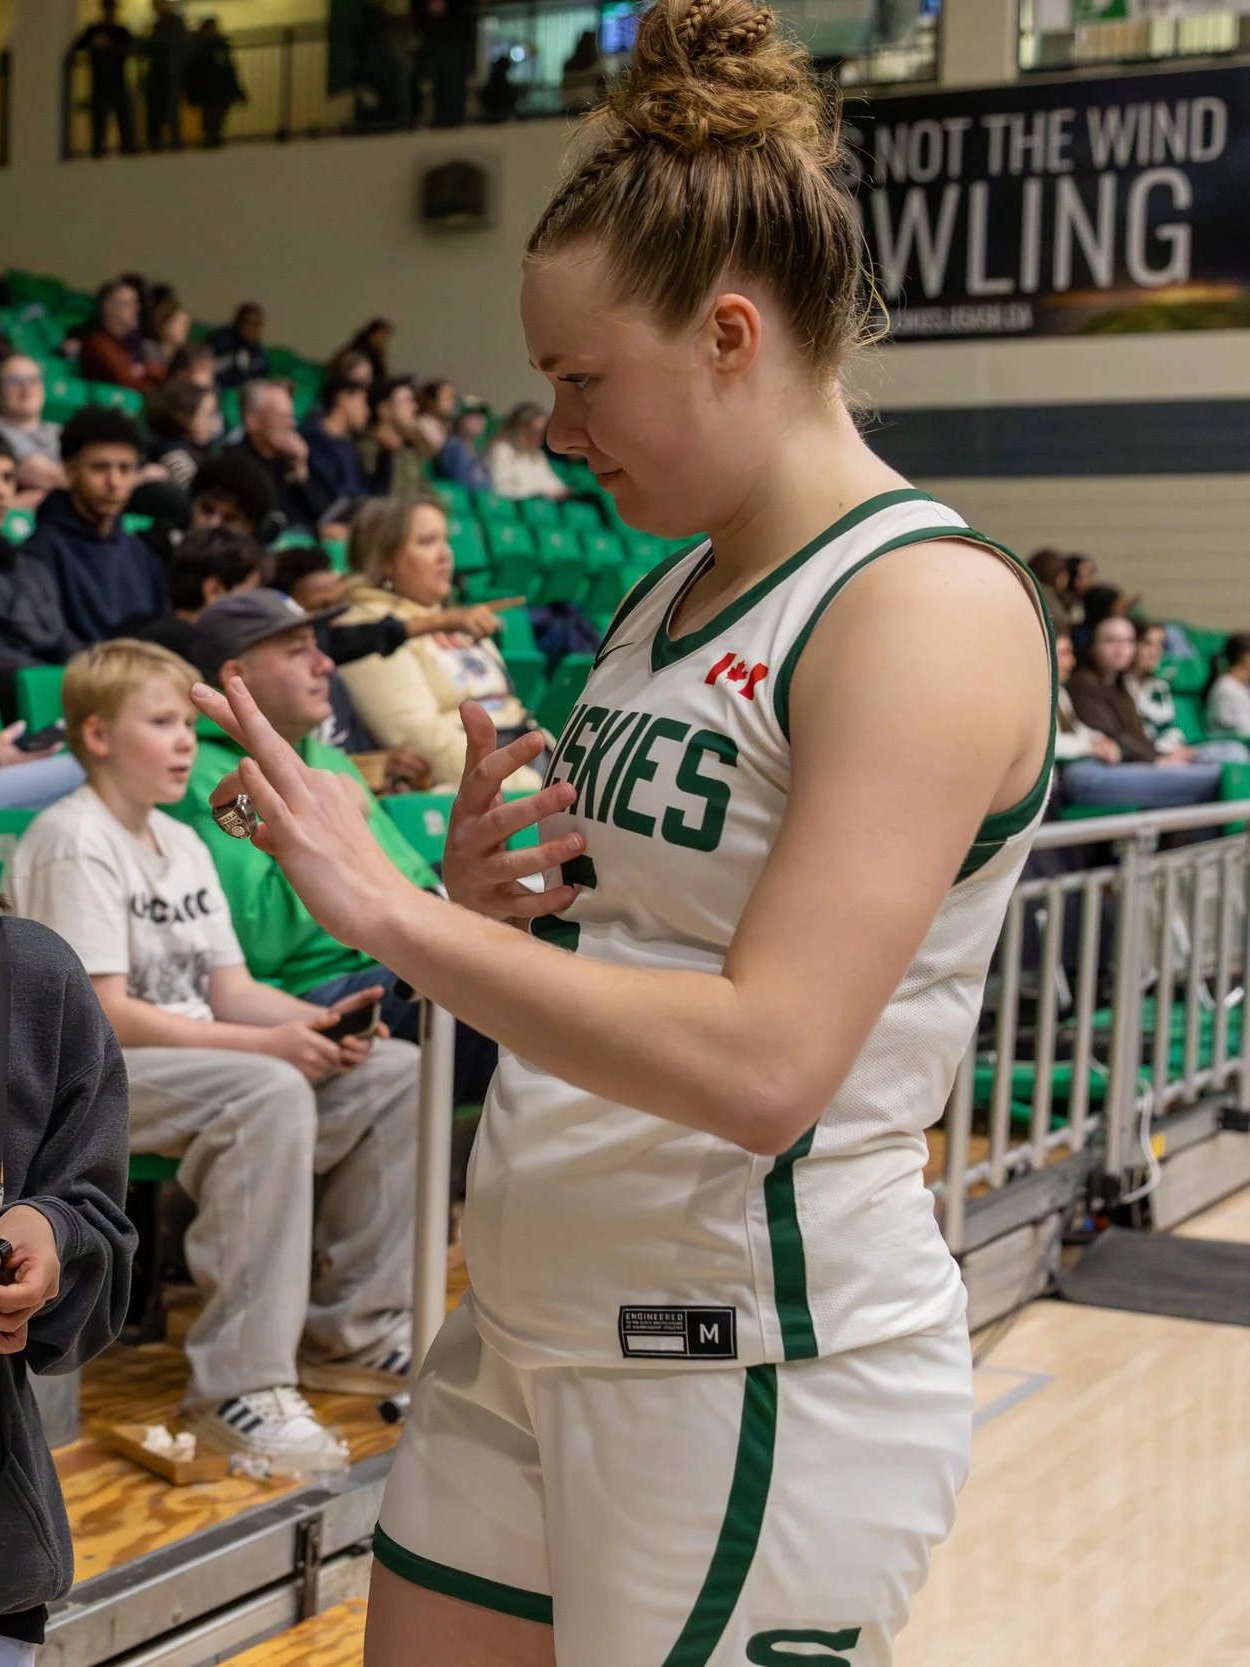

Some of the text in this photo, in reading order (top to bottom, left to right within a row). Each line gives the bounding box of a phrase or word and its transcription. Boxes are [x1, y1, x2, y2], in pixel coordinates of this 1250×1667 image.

[873, 116, 973, 185] NOT
[980, 107, 1076, 177] THE
[1086, 96, 1228, 169] WIND
[854, 166, 1193, 300] WLING
[625, 1312, 684, 1321] ENGINEERED
[698, 1322, 720, 1344] M
